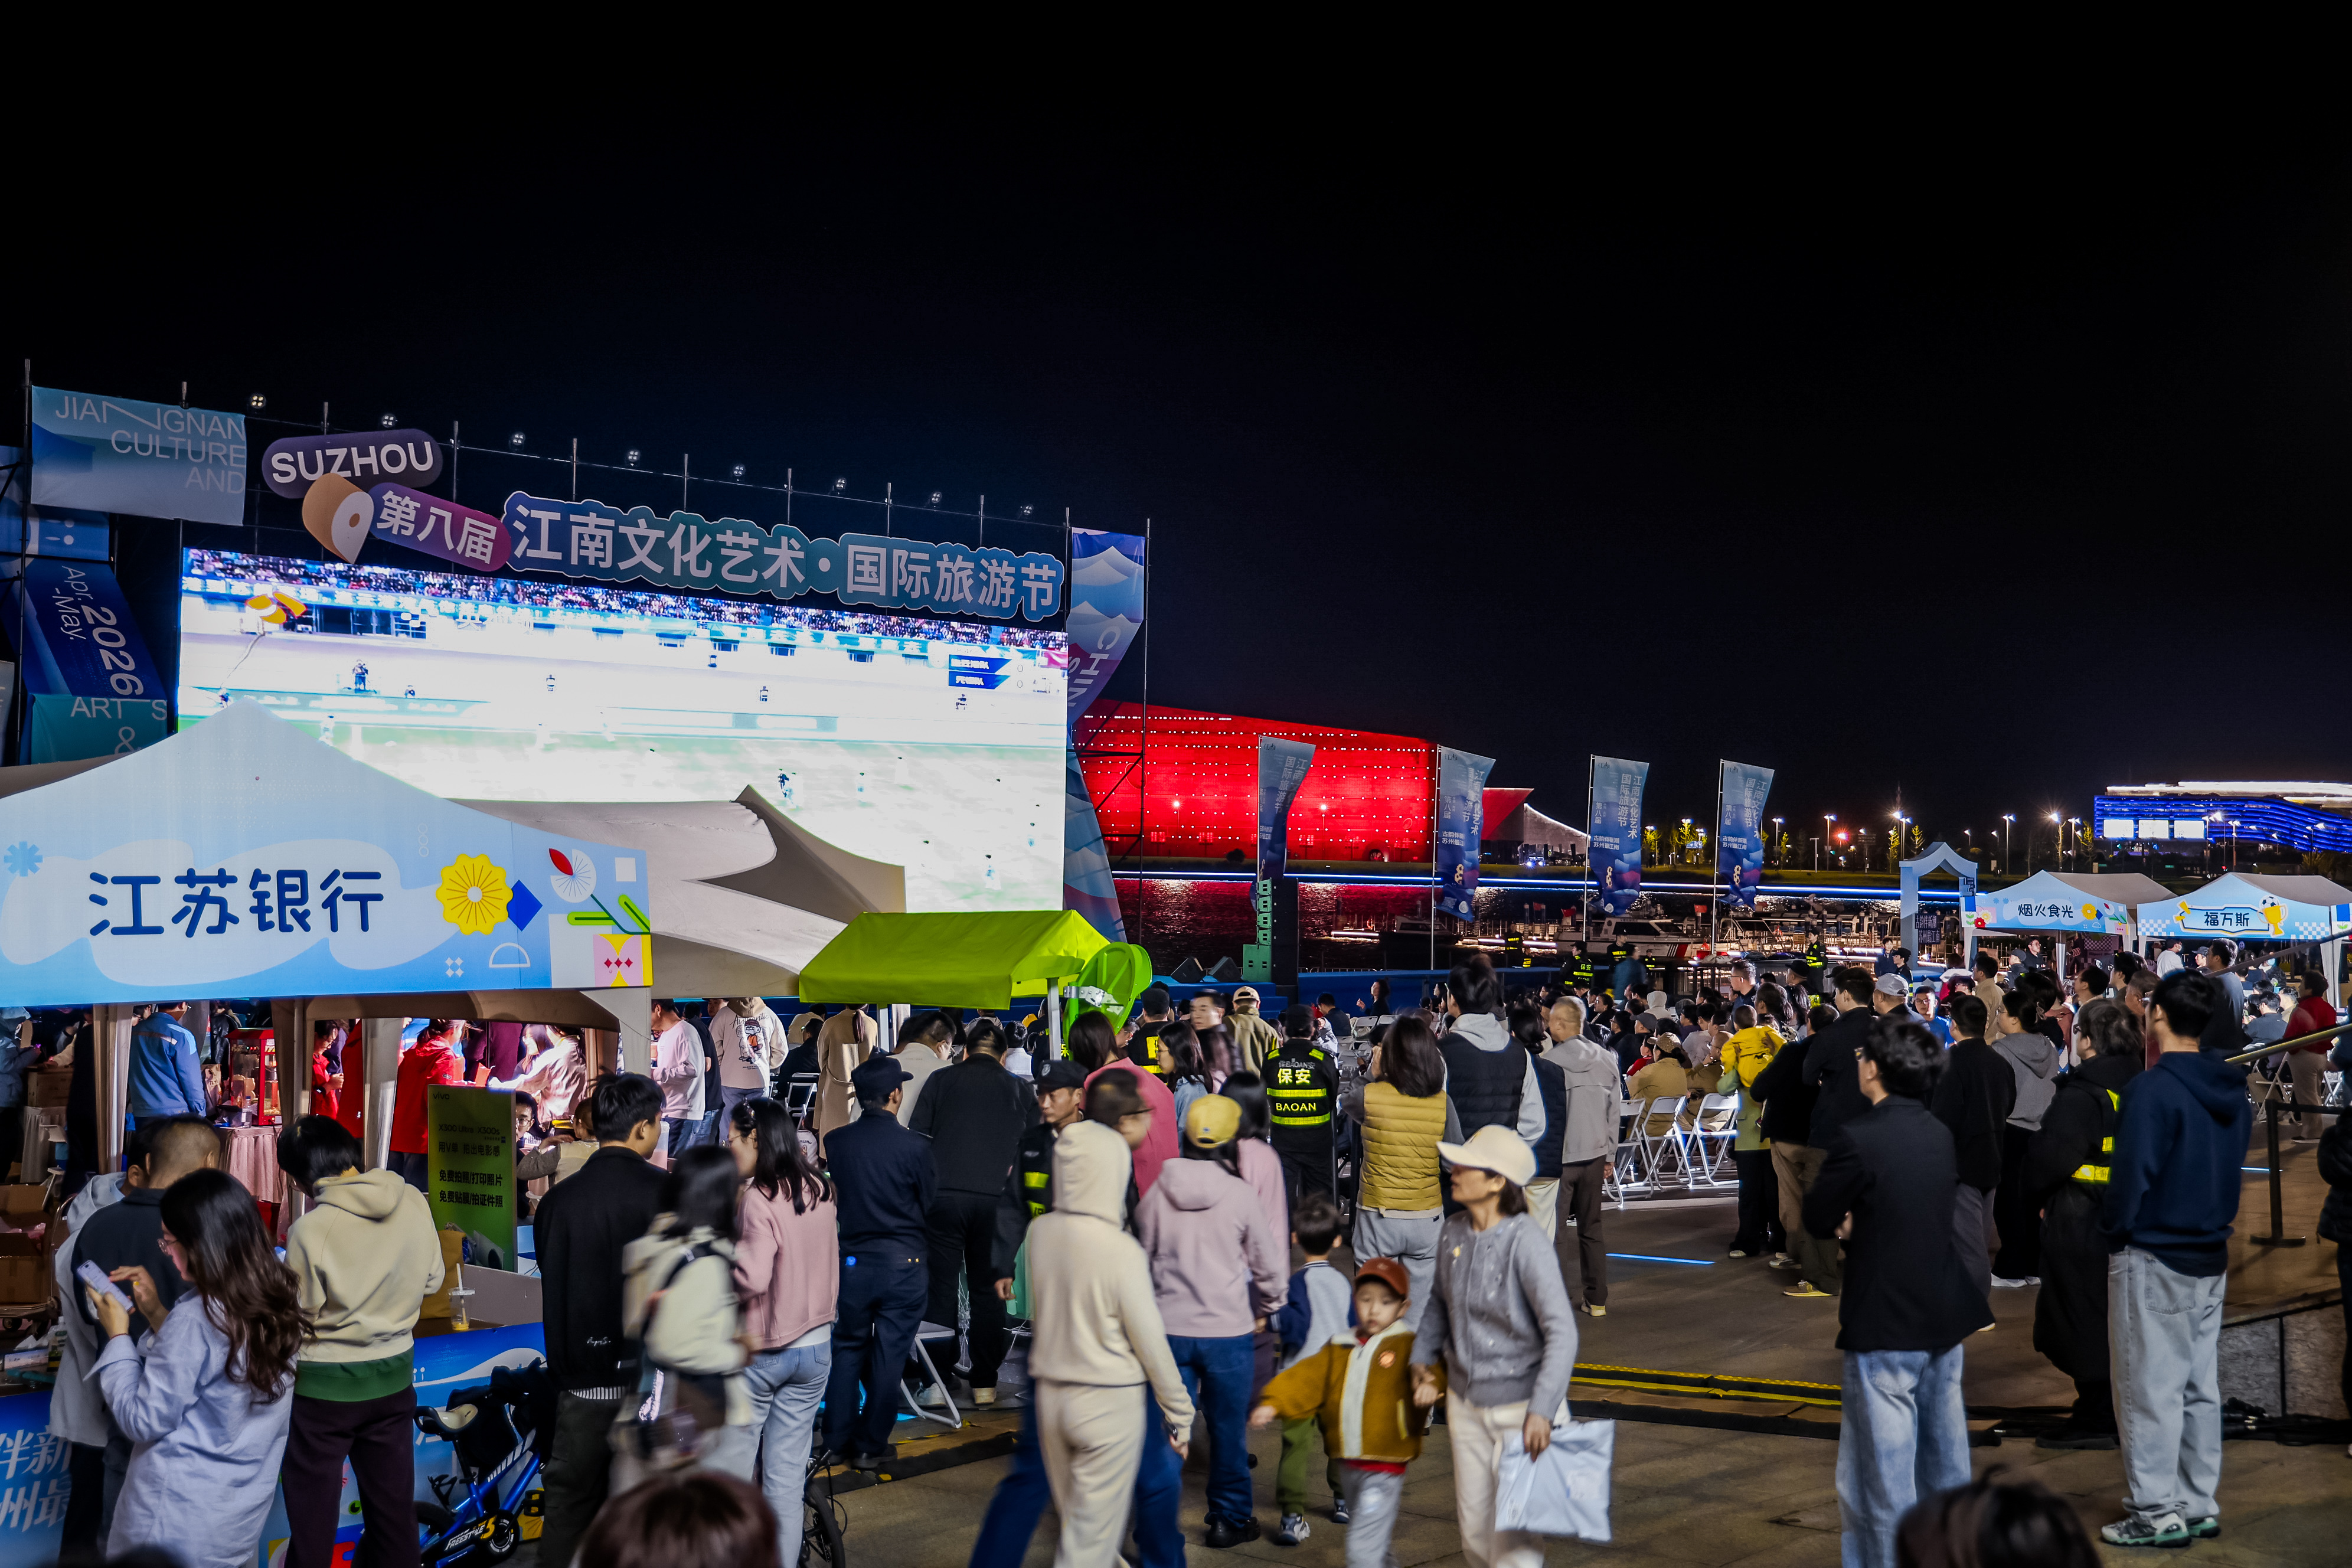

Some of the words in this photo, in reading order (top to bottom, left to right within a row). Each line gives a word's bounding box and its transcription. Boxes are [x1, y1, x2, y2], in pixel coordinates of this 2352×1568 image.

[111, 430, 247, 468] CULTURE
[270, 441, 433, 484] SUZHOU
[185, 466, 246, 494] AND
[377, 490, 497, 564] 第八届
[61, 565, 94, 600] Apr.
[81, 604, 144, 696] 2026
[1443, 795, 1452, 819] 第八届
[1618, 773, 1632, 827] 国际旅游节
[1627, 775, 1642, 839] 江南文化艺术
[1595, 802, 1603, 824] 第八届
[1724, 804, 1732, 826] 第八届
[89, 867, 384, 938] 江苏银行
[2017, 903, 2074, 919] 烟火食光
[2204, 912, 2250, 927] 福万斯
[1278, 1068, 1311, 1084] 保安
[1276, 1102, 1317, 1111] BAOAN
[478, 1126, 500, 1135] X300s
[463, 1143, 500, 1157] 拍出电影感
[439, 1169, 503, 1187] 免费拍照/打印照片
[439, 1190, 504, 1208] 免费贴膜/拍证件照
